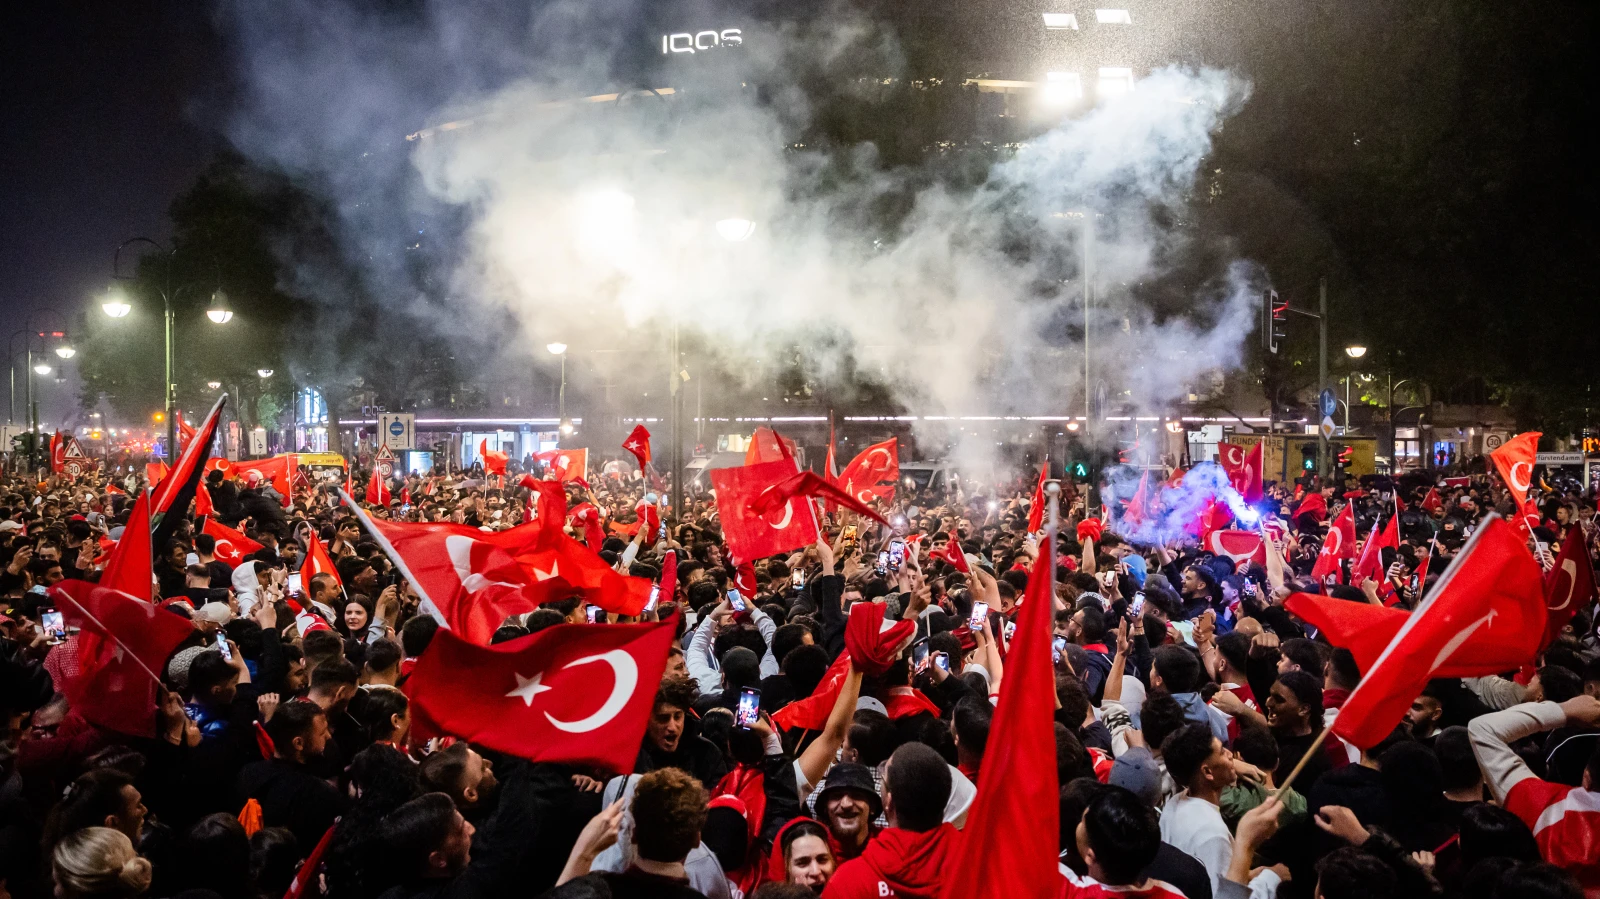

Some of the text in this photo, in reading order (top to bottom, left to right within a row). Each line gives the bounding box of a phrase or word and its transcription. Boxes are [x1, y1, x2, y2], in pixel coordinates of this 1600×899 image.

[663, 28, 742, 54] IQOS
[1231, 437, 1283, 448] FUNDGUBE
[70, 465, 79, 474] 30
[381, 465, 390, 474] 30
